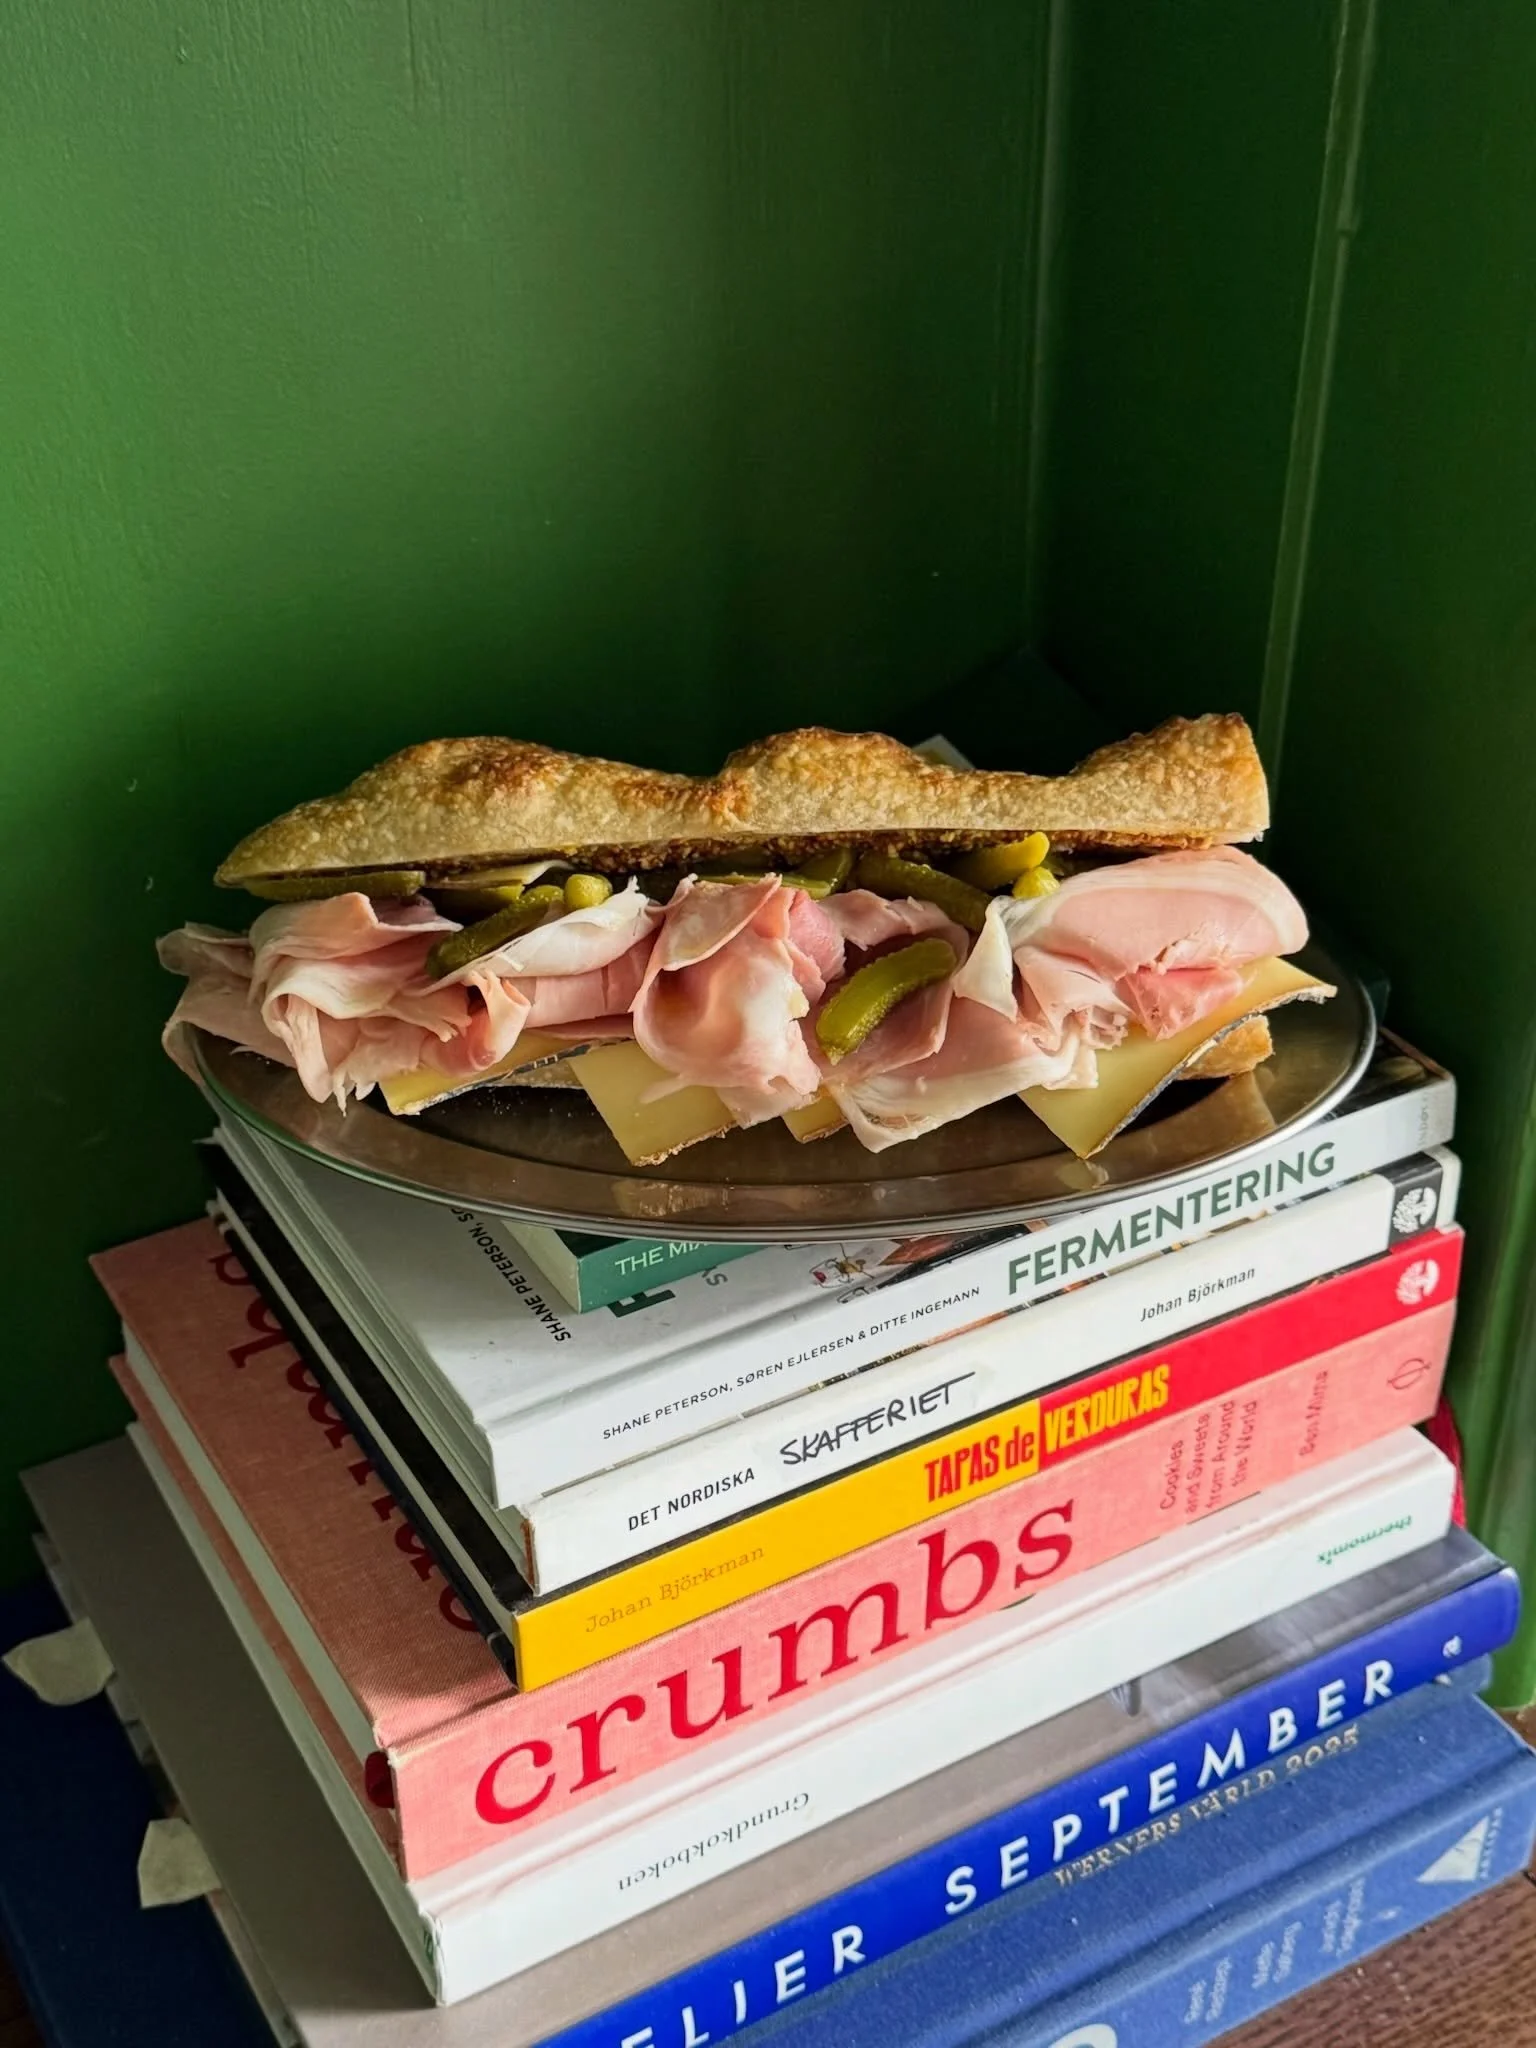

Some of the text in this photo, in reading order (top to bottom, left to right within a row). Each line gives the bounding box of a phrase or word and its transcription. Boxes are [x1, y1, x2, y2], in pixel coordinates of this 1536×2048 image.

[1008, 1142, 1336, 1295] FERMENTERING
[468, 1222, 533, 1294] PETERSON,
[615, 1246, 664, 1275] THE
[524, 1295, 571, 1341] SHANE
[1140, 1266, 1256, 1322] Johan Björkman
[603, 1287, 980, 1439] SHANE PETERSON, SØREN EJLERSEN & DITTE INGEMANN
[780, 1371, 976, 1465] SKAFFERIET
[924, 1364, 1170, 1502] TAPAS de VERDURAS
[1189, 1413, 1211, 1483] Sweets
[1213, 1400, 1235, 1463] Around
[1234, 1400, 1258, 1454] World
[628, 1468, 755, 1531] DET NORDISKA
[1160, 1439, 1184, 1510] Cookies
[1317, 1515, 1412, 1564] thermomix
[585, 1547, 765, 1633] Johan Björkman
[474, 1499, 1075, 1825] crumbs
[945, 1660, 1394, 1915] SEPTEMBER
[617, 1792, 811, 1892] Grundkokboken
